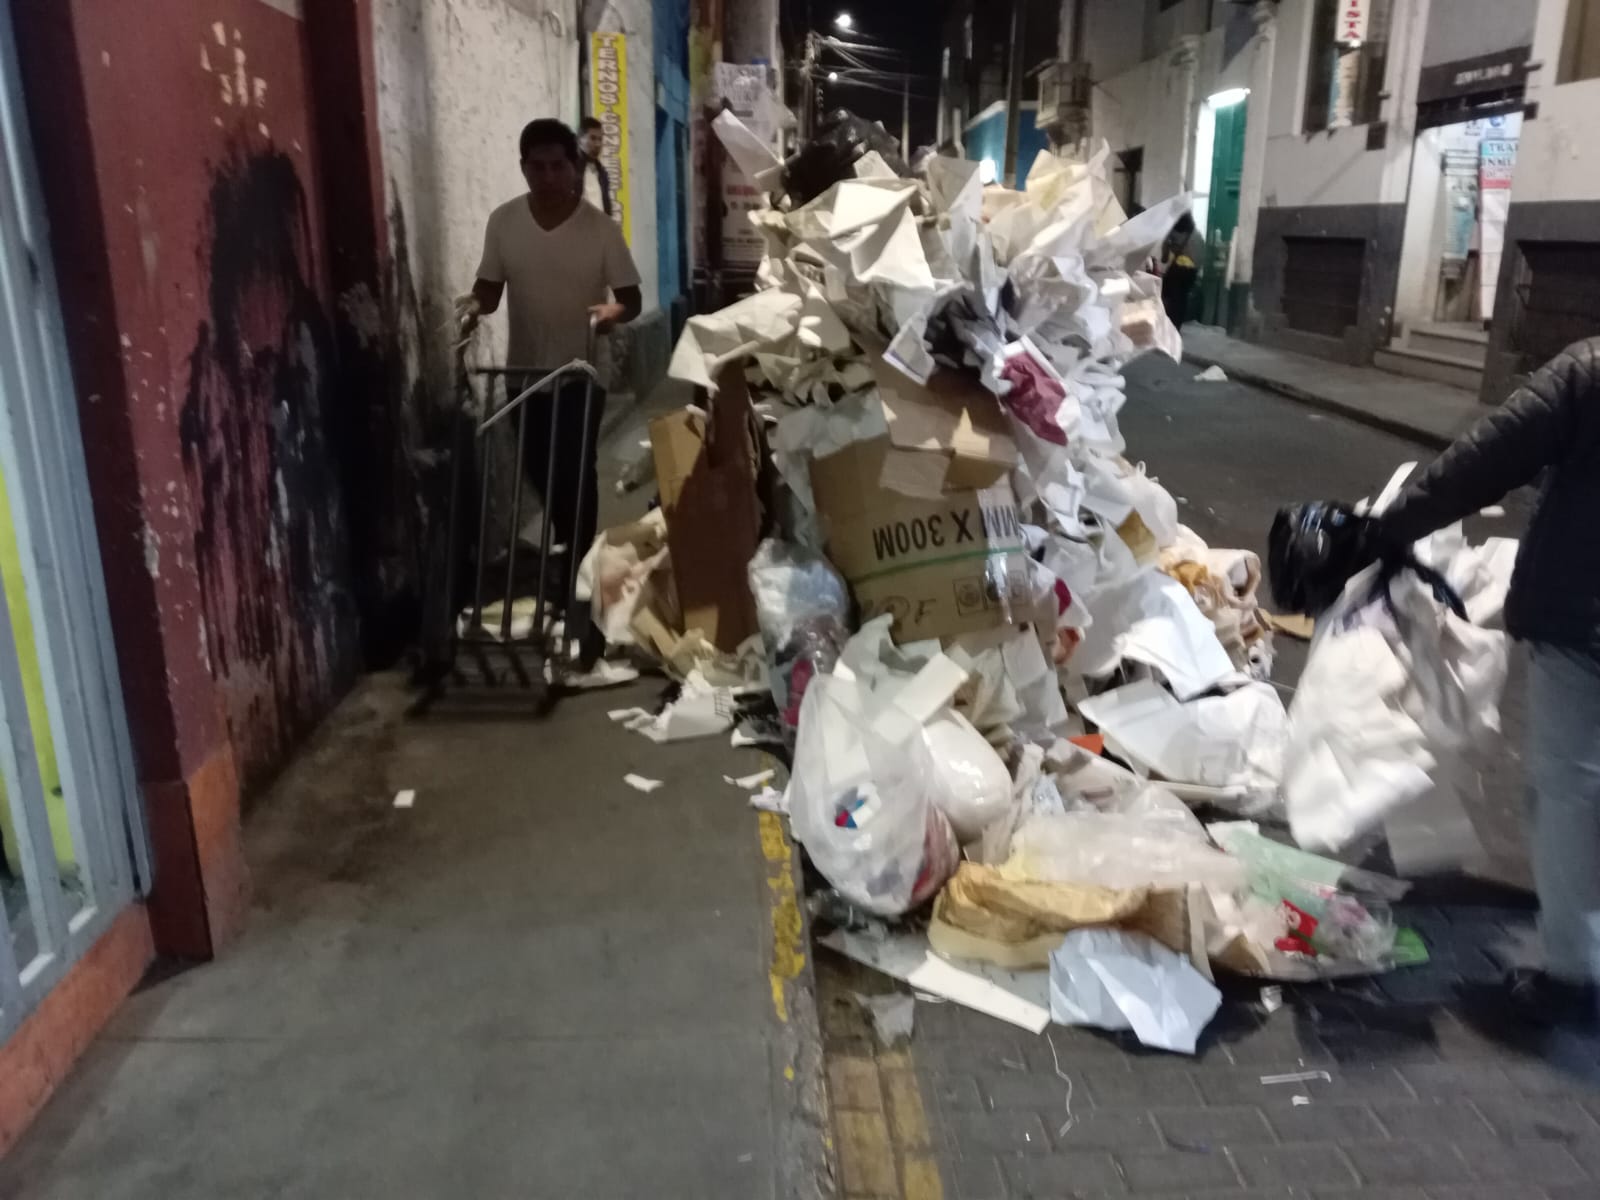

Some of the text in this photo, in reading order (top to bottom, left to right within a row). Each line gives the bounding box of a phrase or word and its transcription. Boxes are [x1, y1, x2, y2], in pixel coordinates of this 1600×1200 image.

[597, 33, 619, 104] TERNOS
[872, 514, 944, 560] 300M
[951, 508, 974, 543] X
